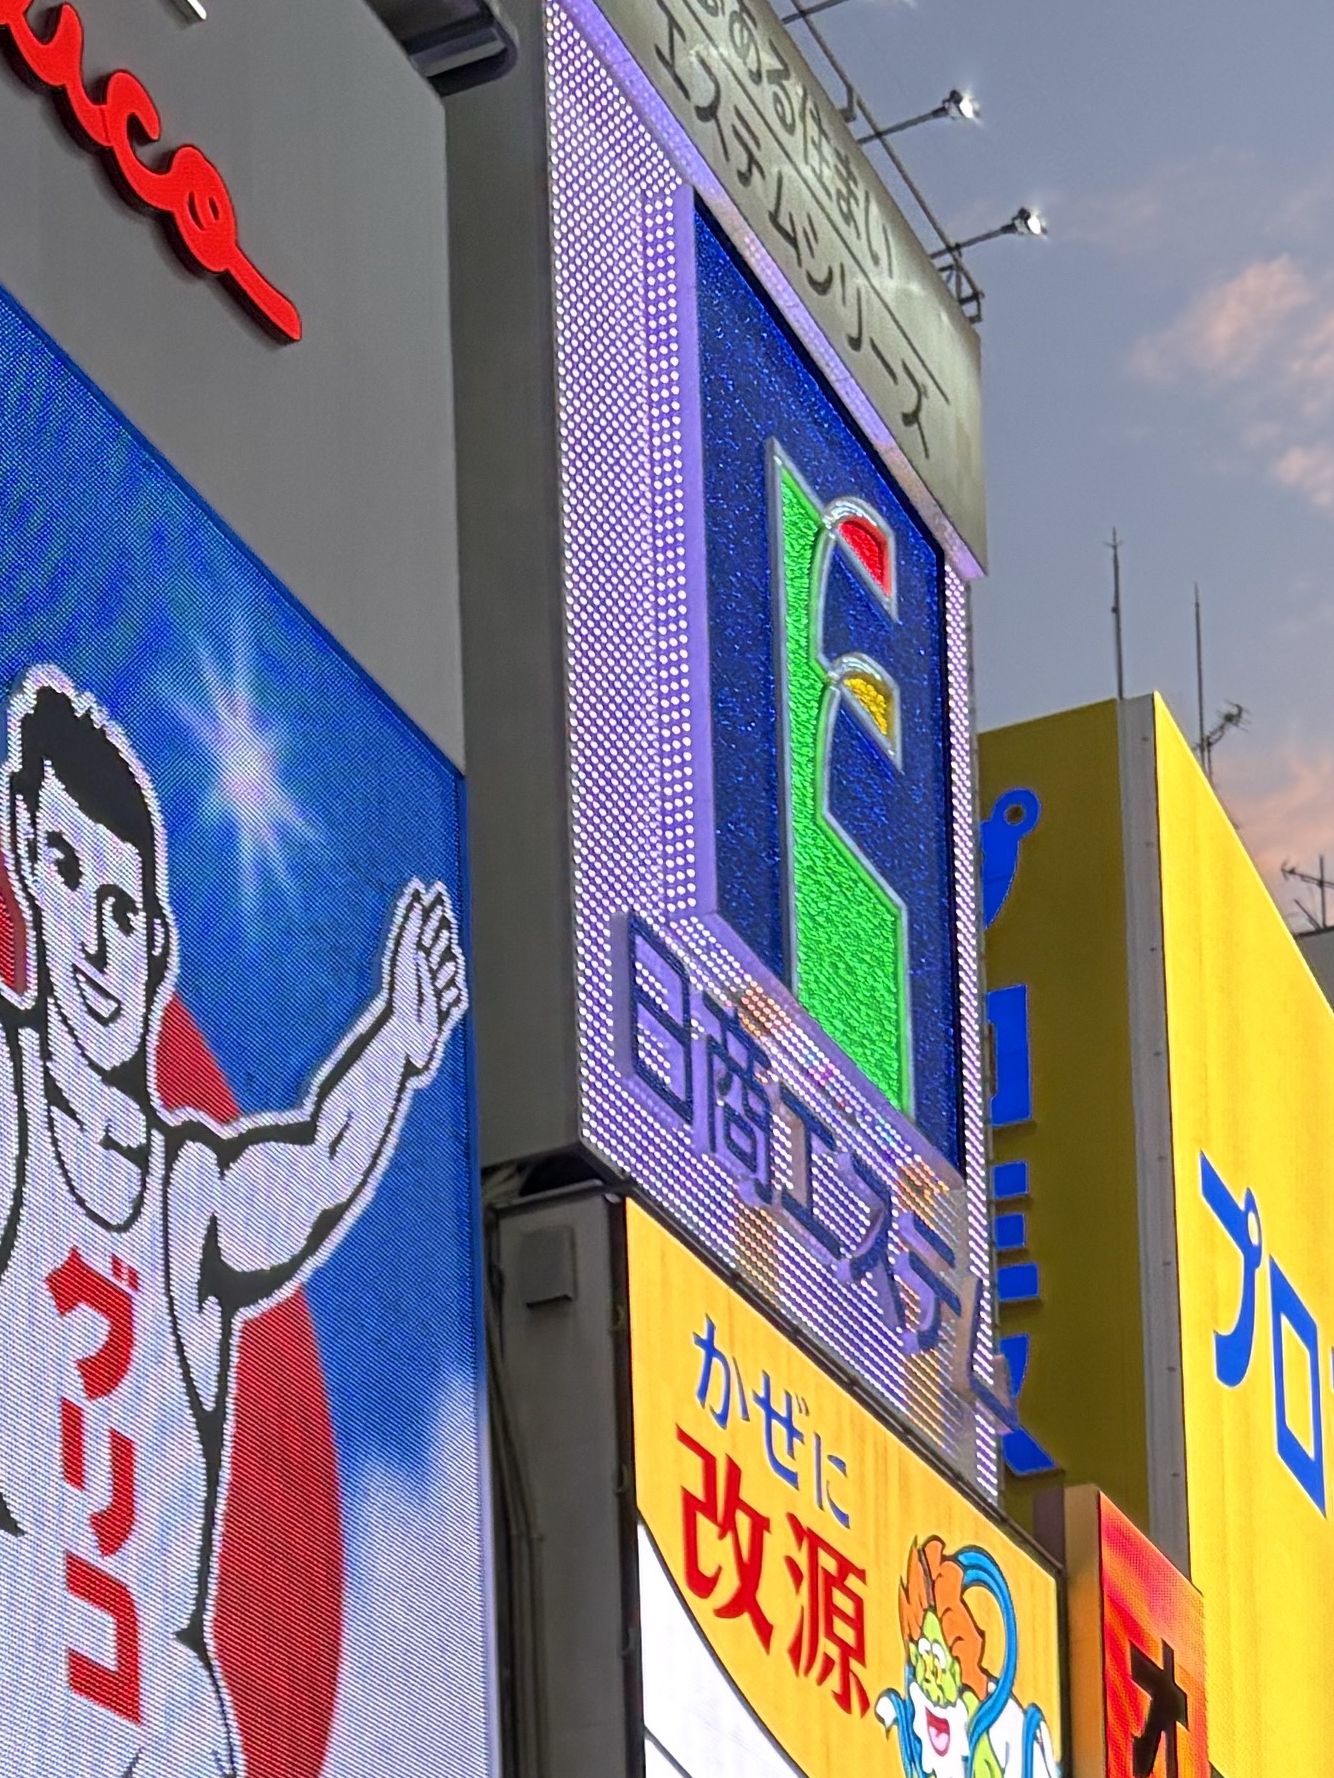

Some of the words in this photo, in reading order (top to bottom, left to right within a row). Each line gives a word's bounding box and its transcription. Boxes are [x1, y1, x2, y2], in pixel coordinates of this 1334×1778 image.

[45, 1246, 143, 1726] グリコ
[691, 1313, 851, 1528] かぜに
[676, 1423, 871, 1719] 改源
